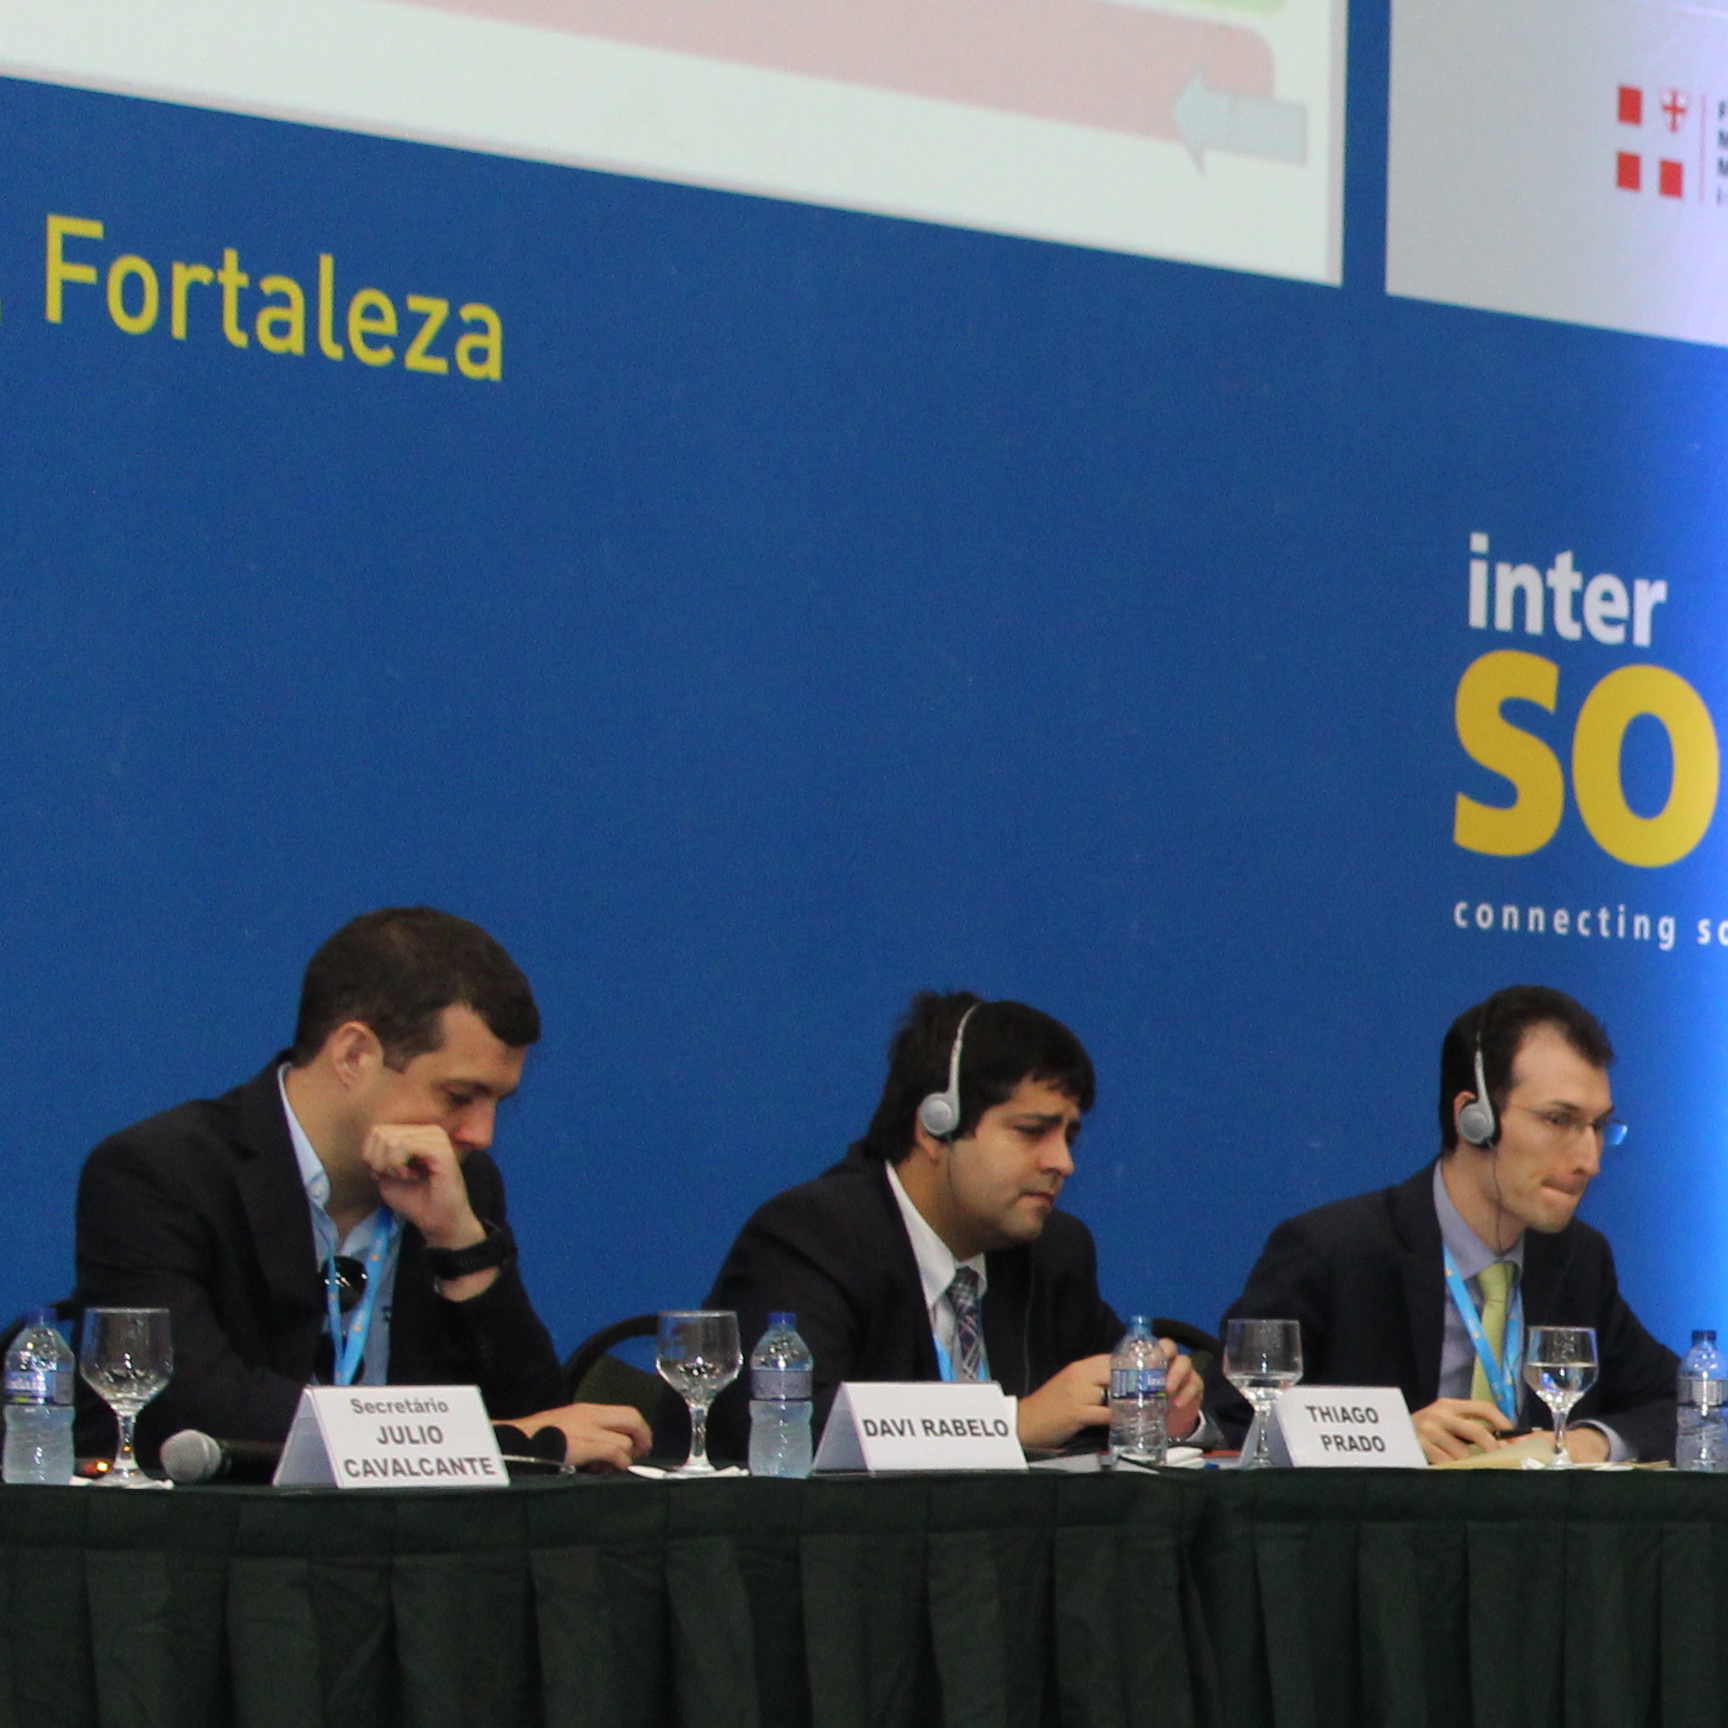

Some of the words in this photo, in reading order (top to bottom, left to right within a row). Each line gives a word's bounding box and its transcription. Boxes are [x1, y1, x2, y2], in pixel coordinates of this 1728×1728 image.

[46, 213, 504, 382] Fortaleza
[1467, 532, 1668, 647] inter
[1453, 900, 1677, 951] connecting
[350, 1397, 450, 1415] Secretário
[1305, 1405, 1380, 1424] THIAGO
[376, 1424, 444, 1446] JULIO
[863, 1418, 917, 1437] DAVI
[921, 1418, 1009, 1438] RABELO
[1320, 1434, 1386, 1453] PRADO
[344, 1456, 497, 1479] CAVALCANTE
